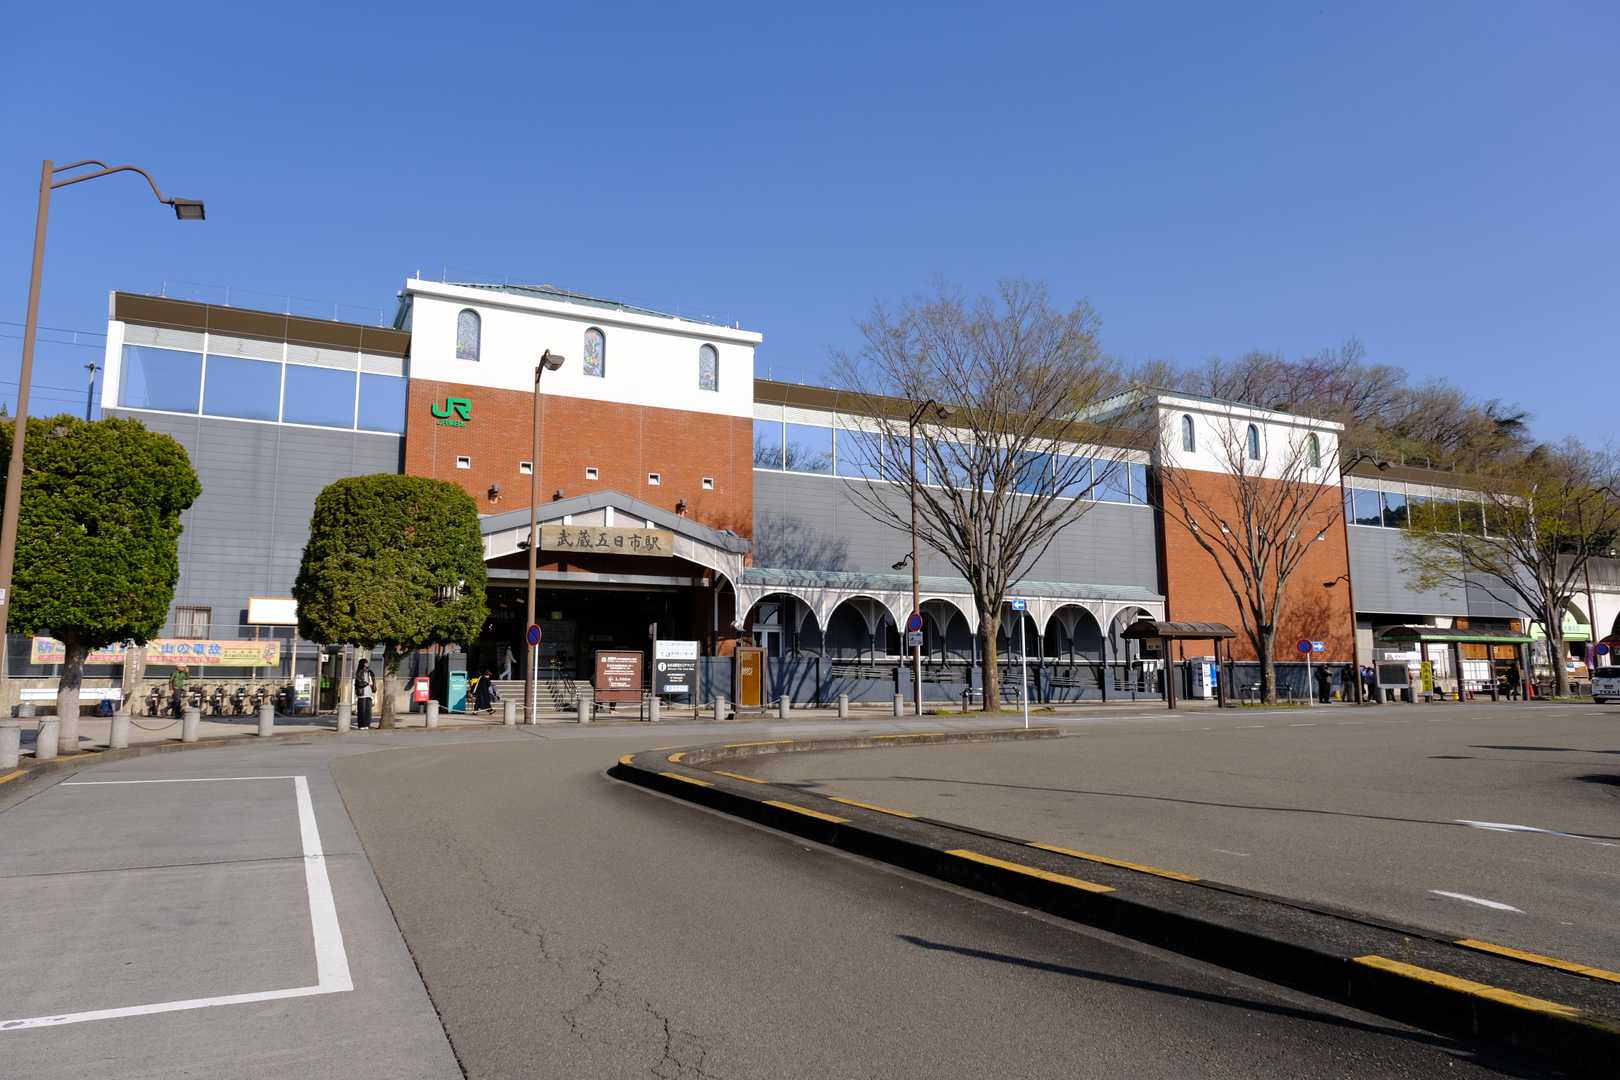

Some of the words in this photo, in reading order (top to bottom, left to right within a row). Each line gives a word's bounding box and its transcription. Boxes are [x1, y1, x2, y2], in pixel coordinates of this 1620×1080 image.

[431, 397, 472, 420] JR
[557, 528, 661, 552] 武蔵五日市駅
